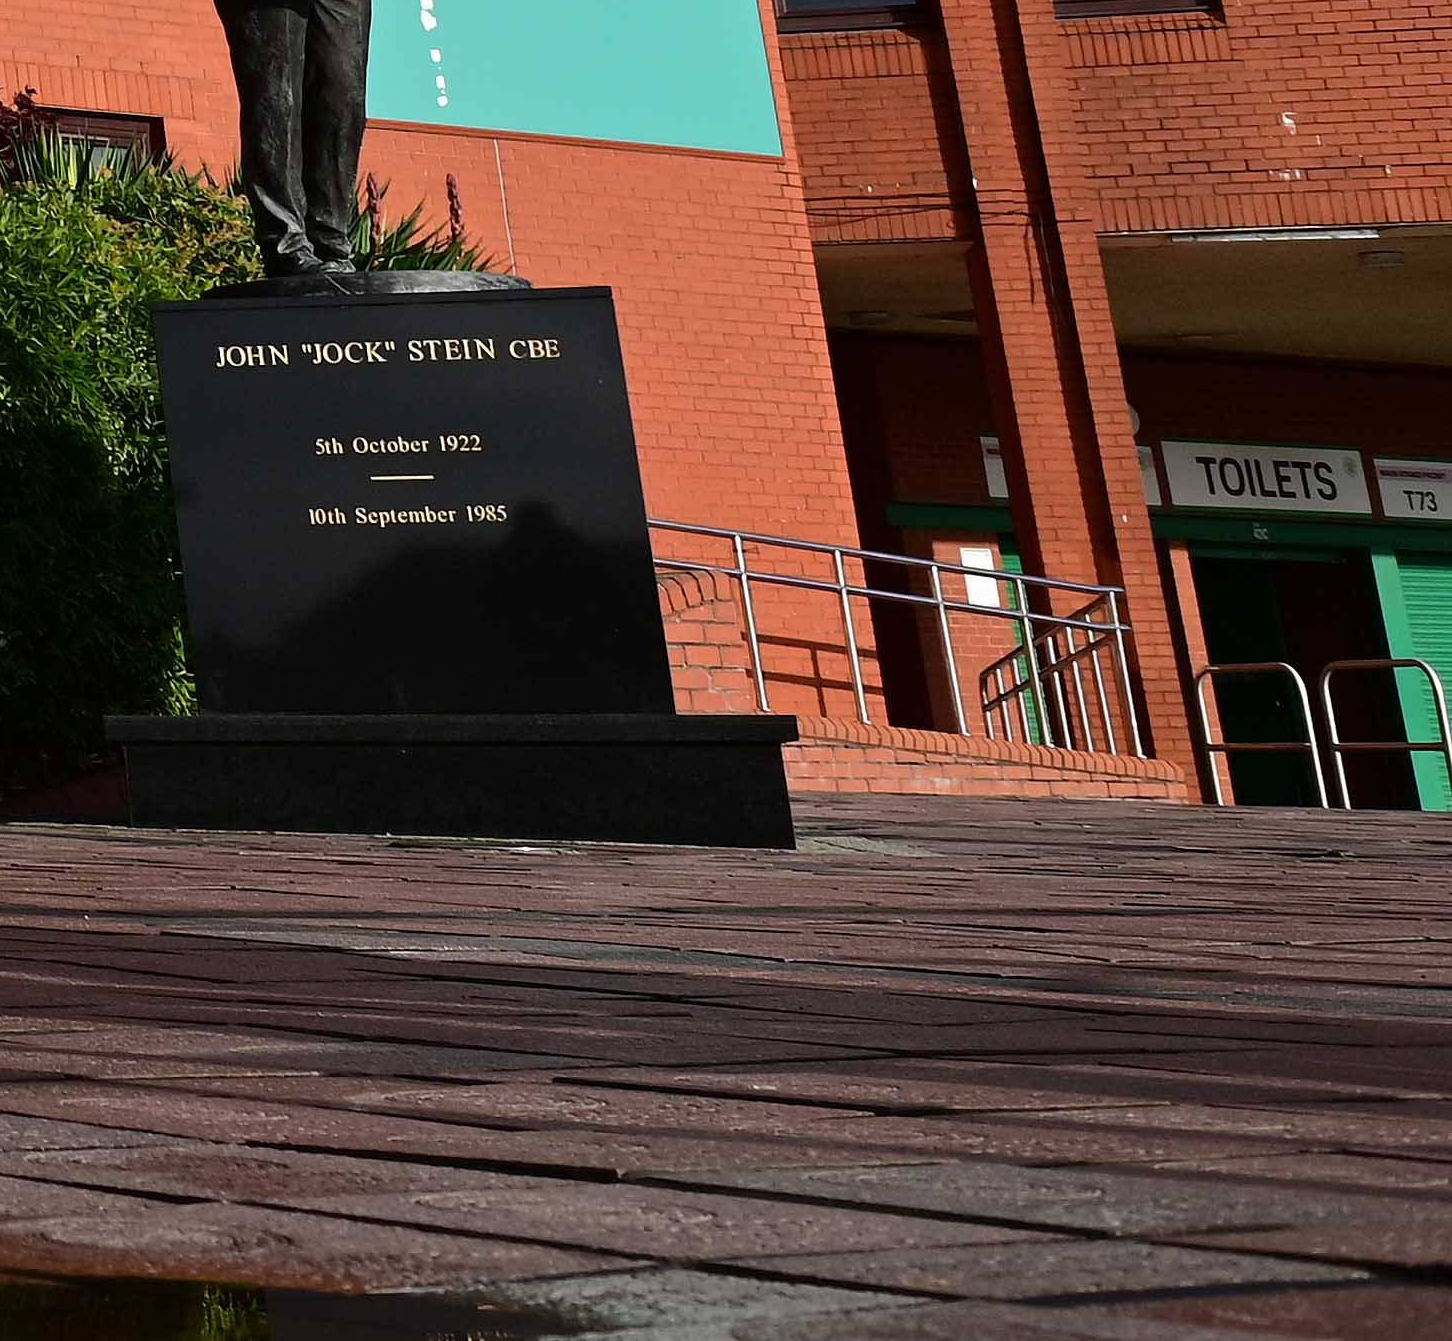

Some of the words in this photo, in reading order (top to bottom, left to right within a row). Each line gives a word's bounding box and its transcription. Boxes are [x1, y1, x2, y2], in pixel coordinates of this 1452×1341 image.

[216, 344, 289, 368] JOHN
[301, 341, 396, 365] "JOCK"
[407, 338, 495, 362] STEIN
[509, 338, 561, 359] CBE
[315, 436, 344, 455] 5th
[352, 435, 430, 454] October
[439, 434, 482, 452] 1922
[1195, 455, 1338, 502] TOILETS
[1402, 489, 1438, 512] T73
[308, 507, 347, 525] 10th
[355, 505, 457, 528] September
[466, 504, 508, 522] 1985
